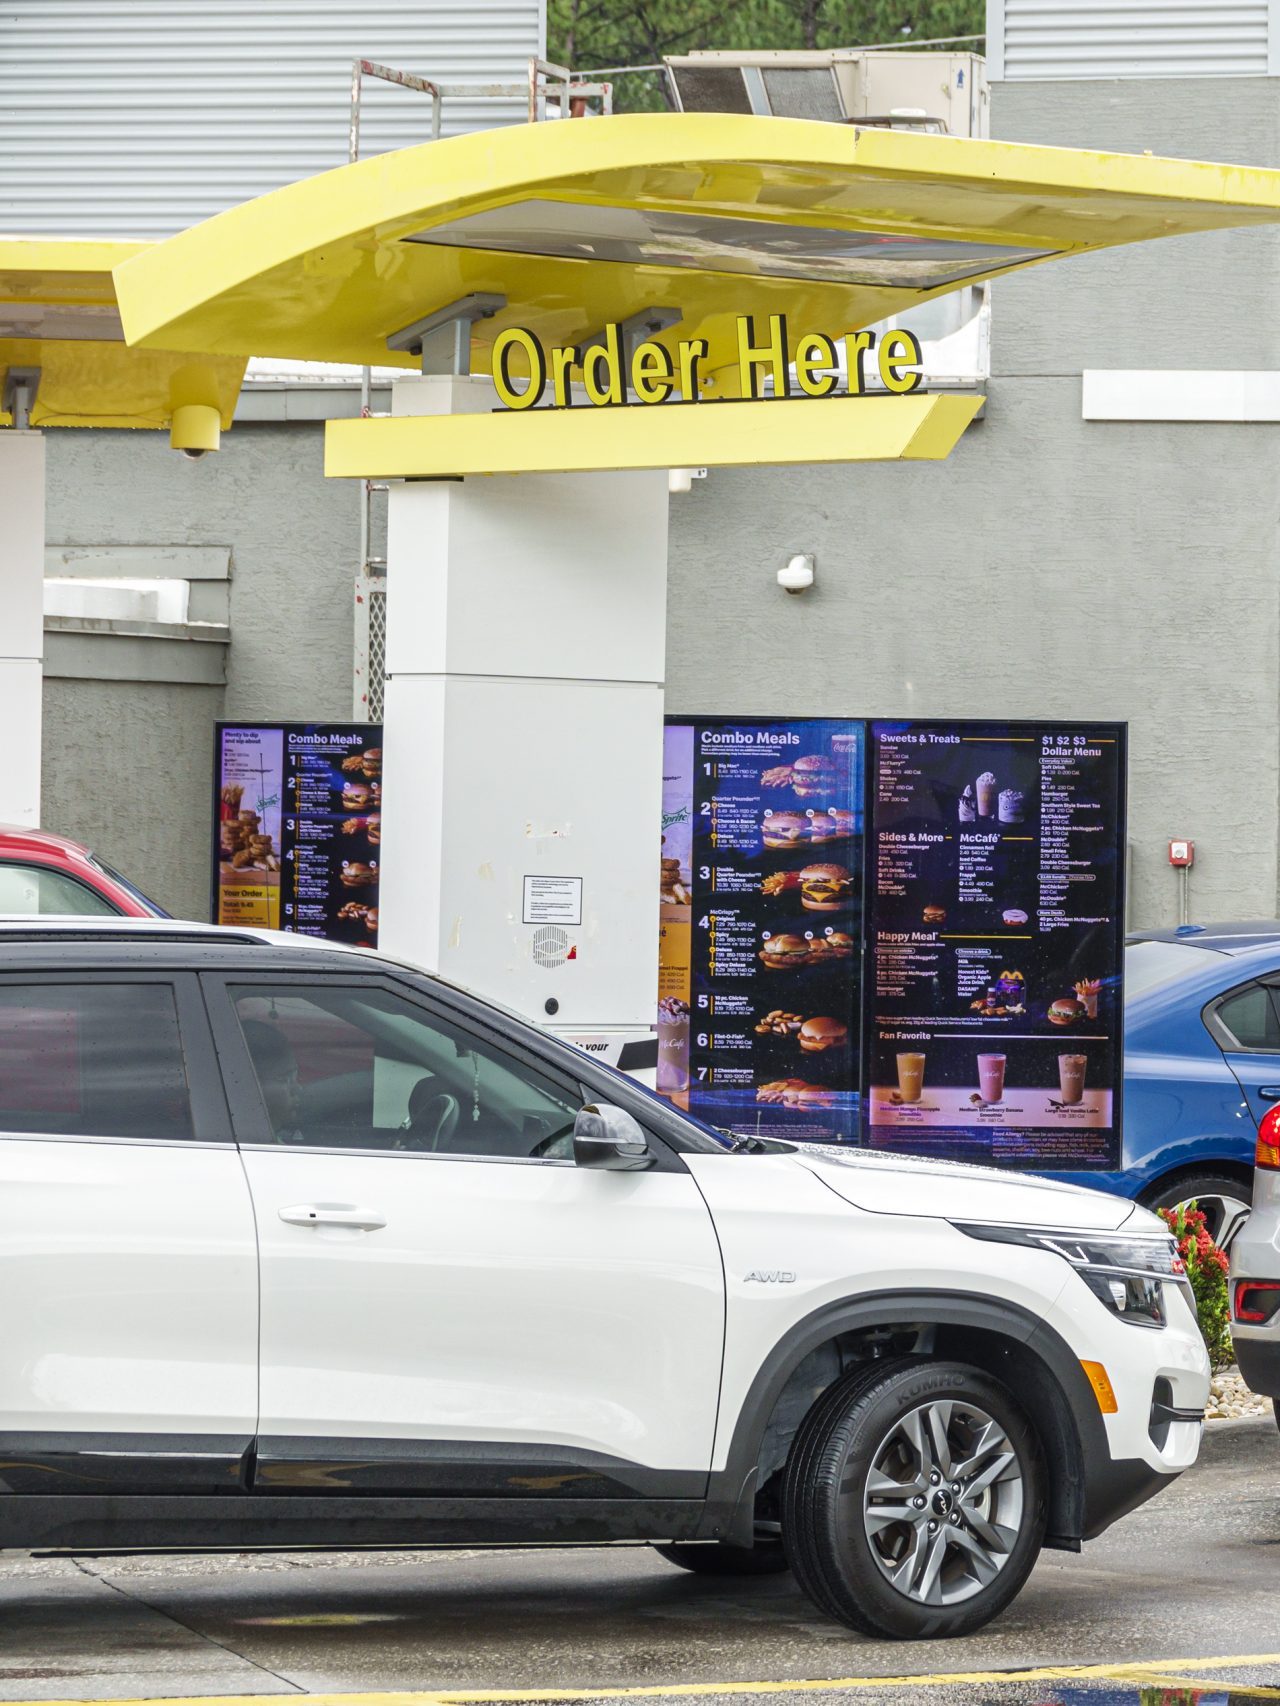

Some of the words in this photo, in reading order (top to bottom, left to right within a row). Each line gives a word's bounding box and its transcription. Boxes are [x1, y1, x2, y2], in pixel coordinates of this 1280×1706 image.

[491, 323, 709, 410] Order
[736, 314, 924, 399] Here
[288, 734, 327, 744] Combo
[330, 734, 363, 745] Meals
[701, 731, 753, 744] Combo
[757, 732, 800, 744] Meals
[880, 734, 917, 743] Sweets
[919, 735, 927, 743] &
[928, 735, 960, 743] Treats
[1042, 736, 1053, 745] $1
[1057, 736, 1070, 745] $2
[1073, 736, 1086, 746] $3
[1042, 747, 1072, 756] Dollar
[1074, 748, 1101, 756] Menu
[290, 756, 296, 766] 1
[703, 762, 711, 776] 1
[288, 778, 296, 788] 2
[701, 802, 711, 815] 2
[287, 820, 295, 830] 3
[879, 833, 906, 842] Sides
[908, 833, 917, 842] &
[918, 833, 944, 842] More
[286, 850, 294, 861] 4
[700, 866, 710, 879] 3
[242, 889, 263, 897] Order
[286, 905, 293, 914] 5
[699, 916, 710, 929] 4
[877, 931, 910, 942] Happy
[698, 995, 708, 1008] 5
[697, 1033, 708, 1047] 6
[896, 1032, 931, 1040] Favorite
[697, 1067, 707, 1080] 7
[742, 1269, 797, 1284] AWD
